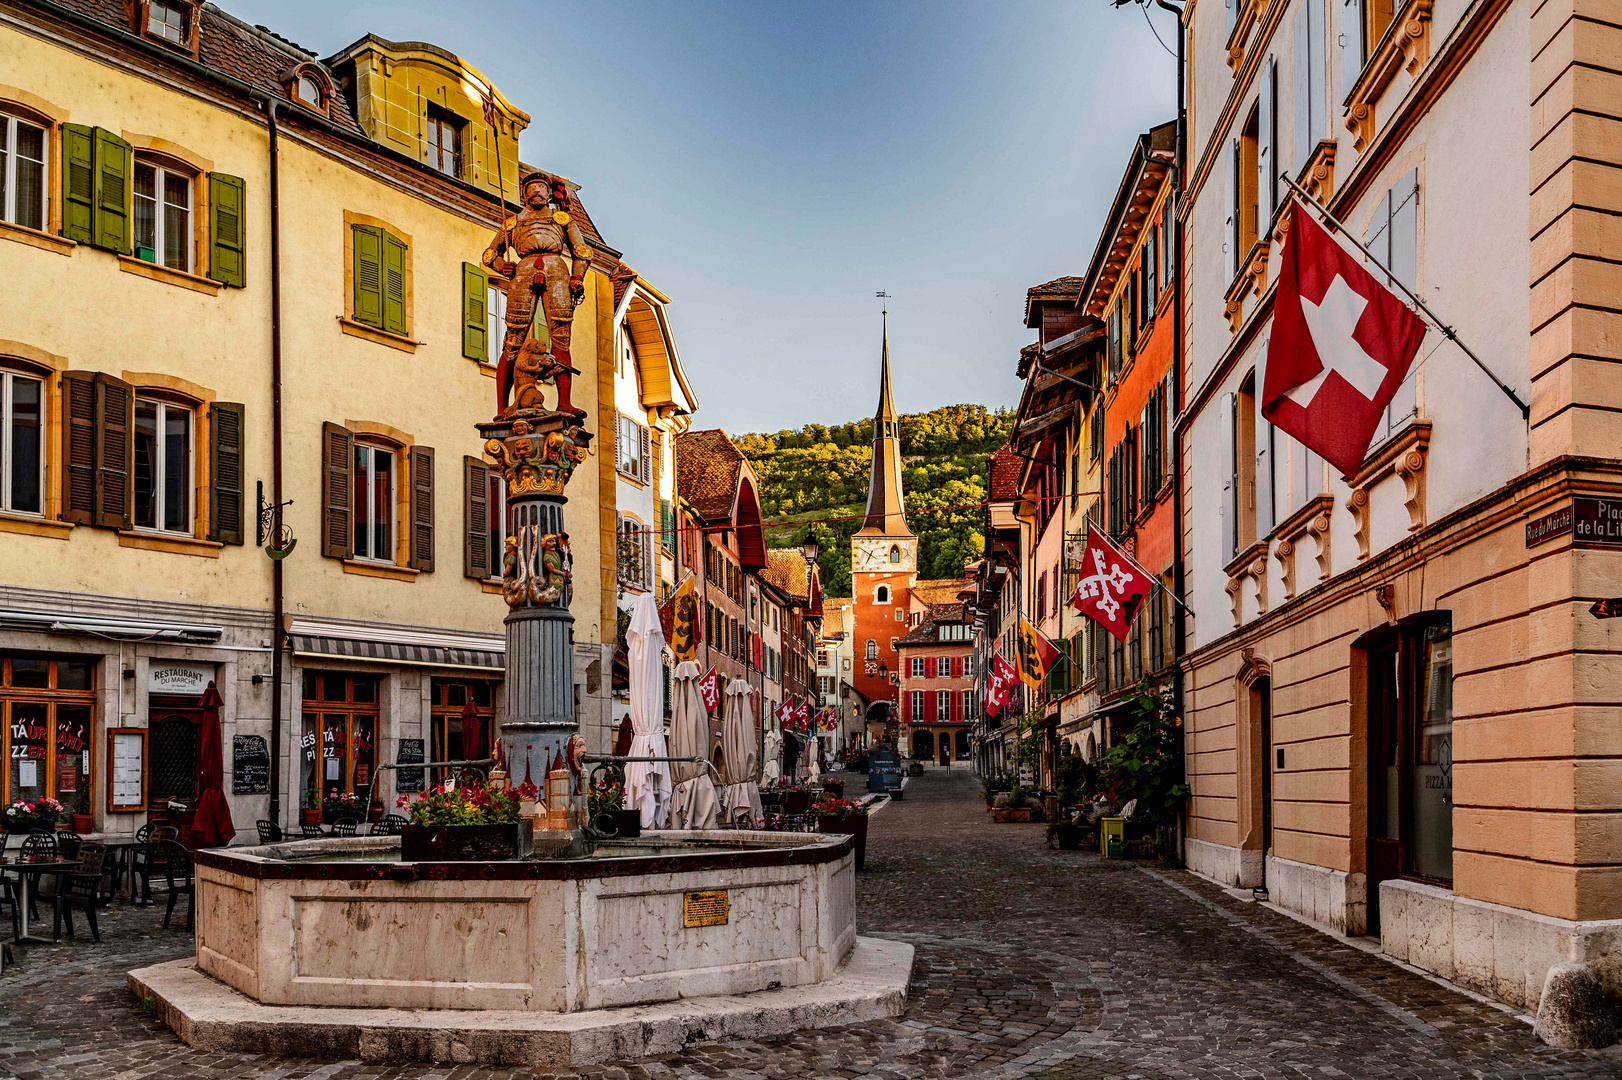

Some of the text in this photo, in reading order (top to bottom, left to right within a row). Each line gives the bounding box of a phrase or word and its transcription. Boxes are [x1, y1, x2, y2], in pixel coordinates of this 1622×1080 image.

[1527, 512, 1570, 541] Rue du Marché
[1577, 519, 1591, 535] de
[1593, 520, 1604, 536] la
[154, 668, 203, 683] RESTAURANT
[160, 677, 170, 685] DU
[1425, 775, 1445, 789] PIZZA
